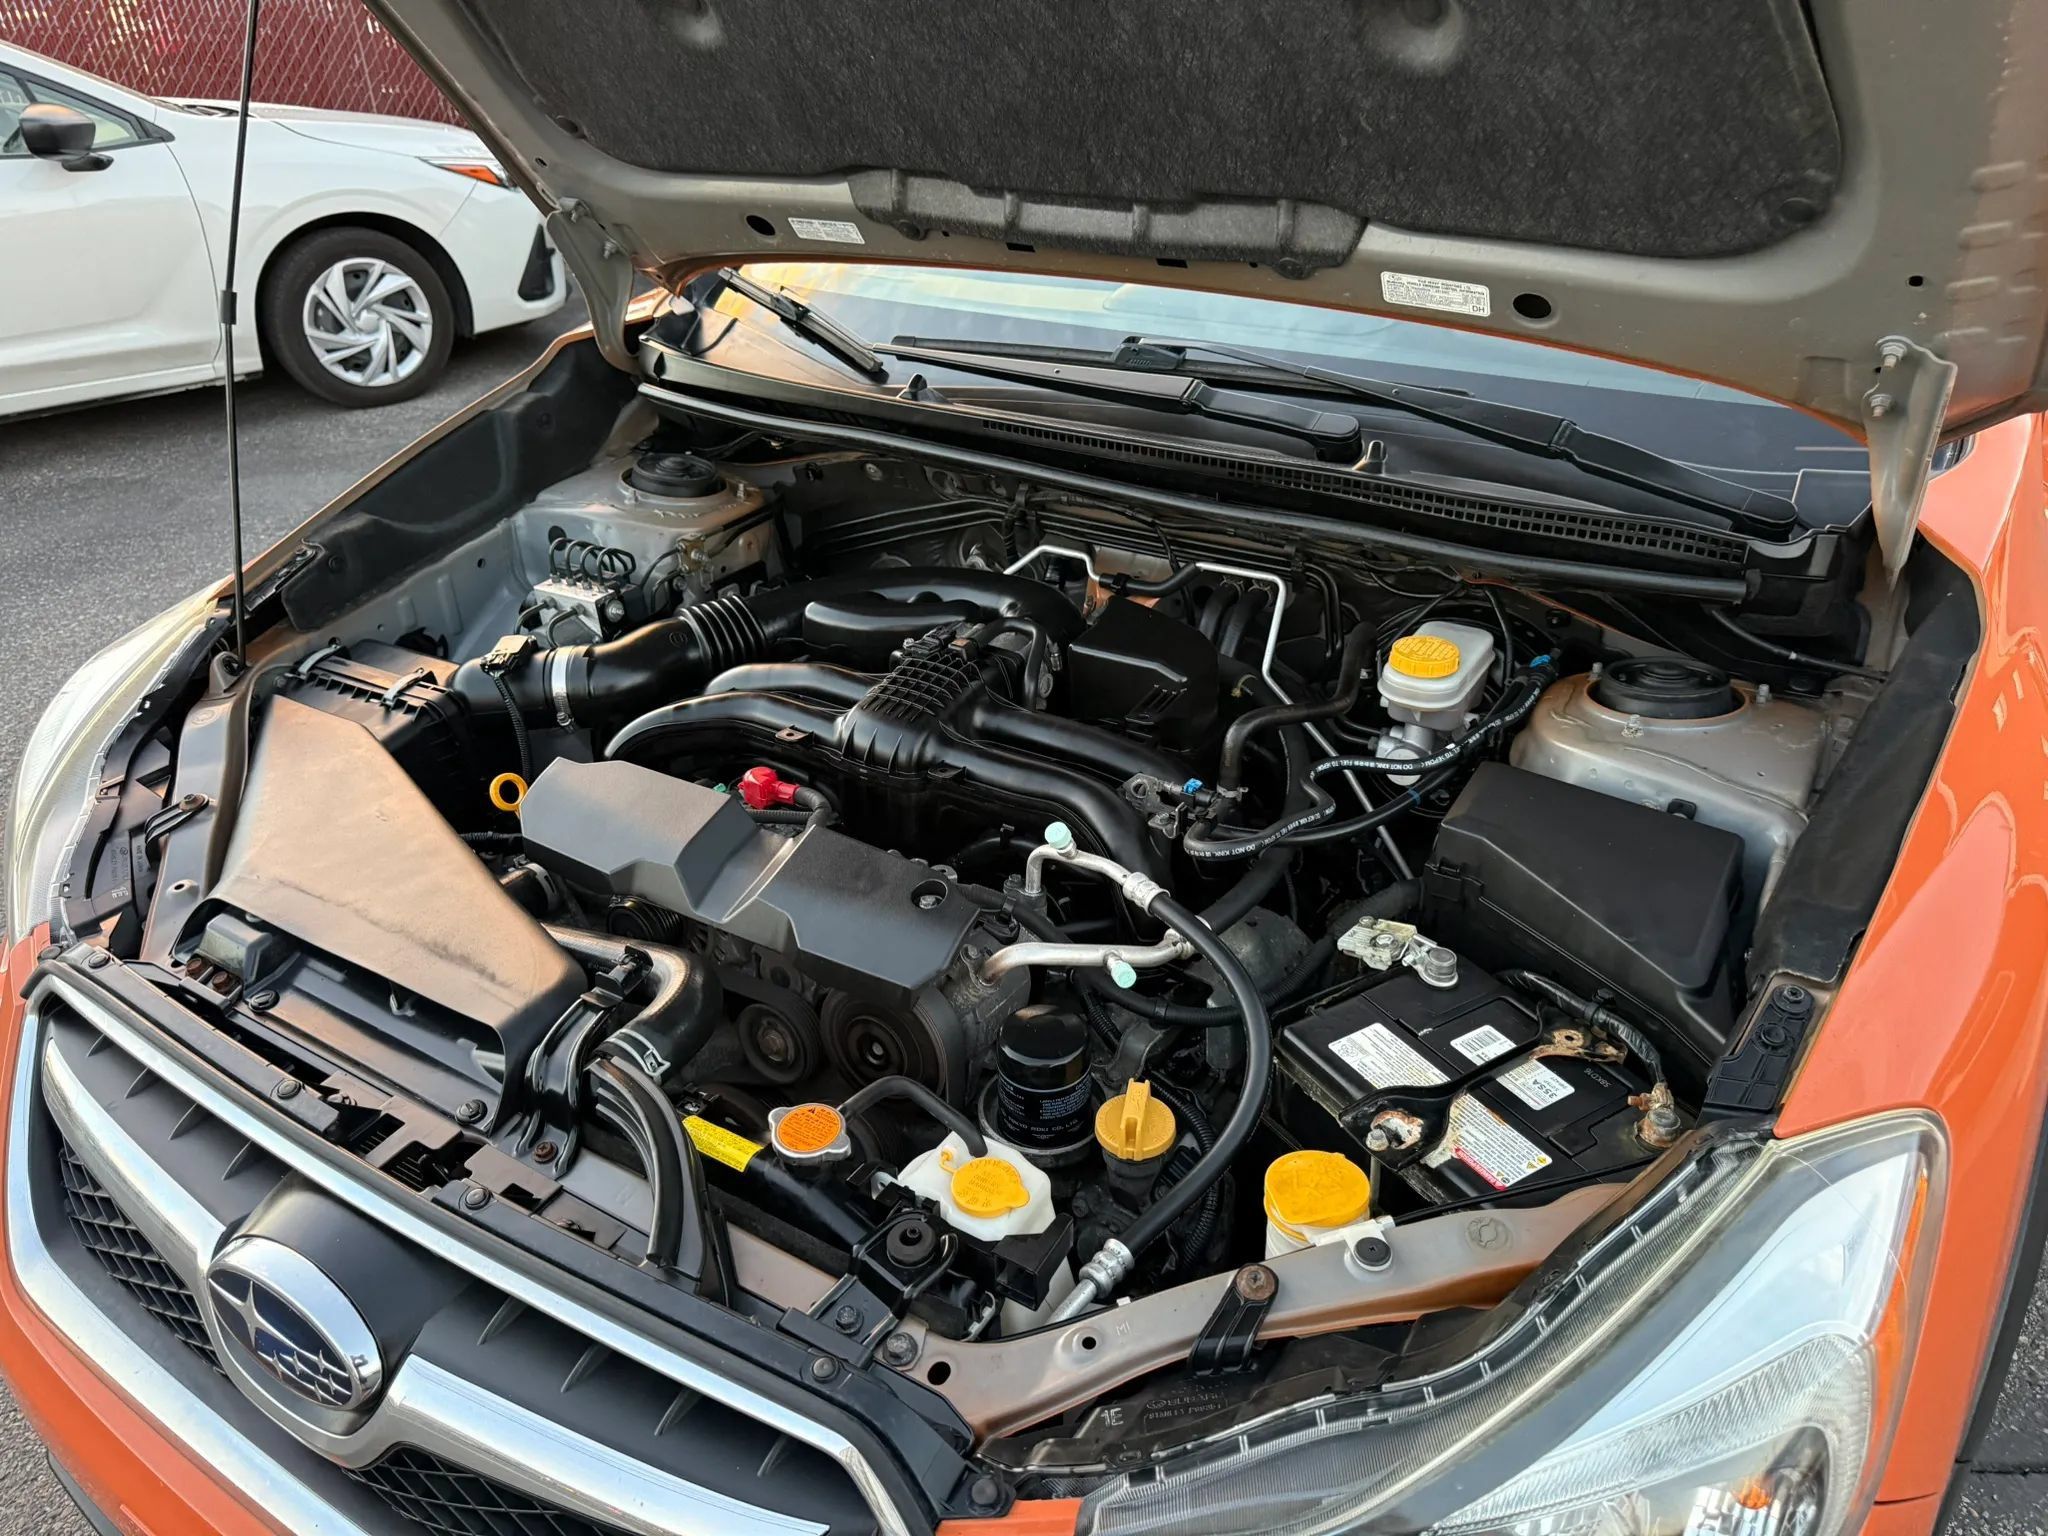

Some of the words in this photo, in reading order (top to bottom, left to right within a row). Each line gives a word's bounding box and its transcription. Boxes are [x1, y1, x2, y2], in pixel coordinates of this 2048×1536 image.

[1472, 305, 1485, 313] DH
[1232, 847, 1246, 856] NOT
[1246, 844, 1256, 852] DO
